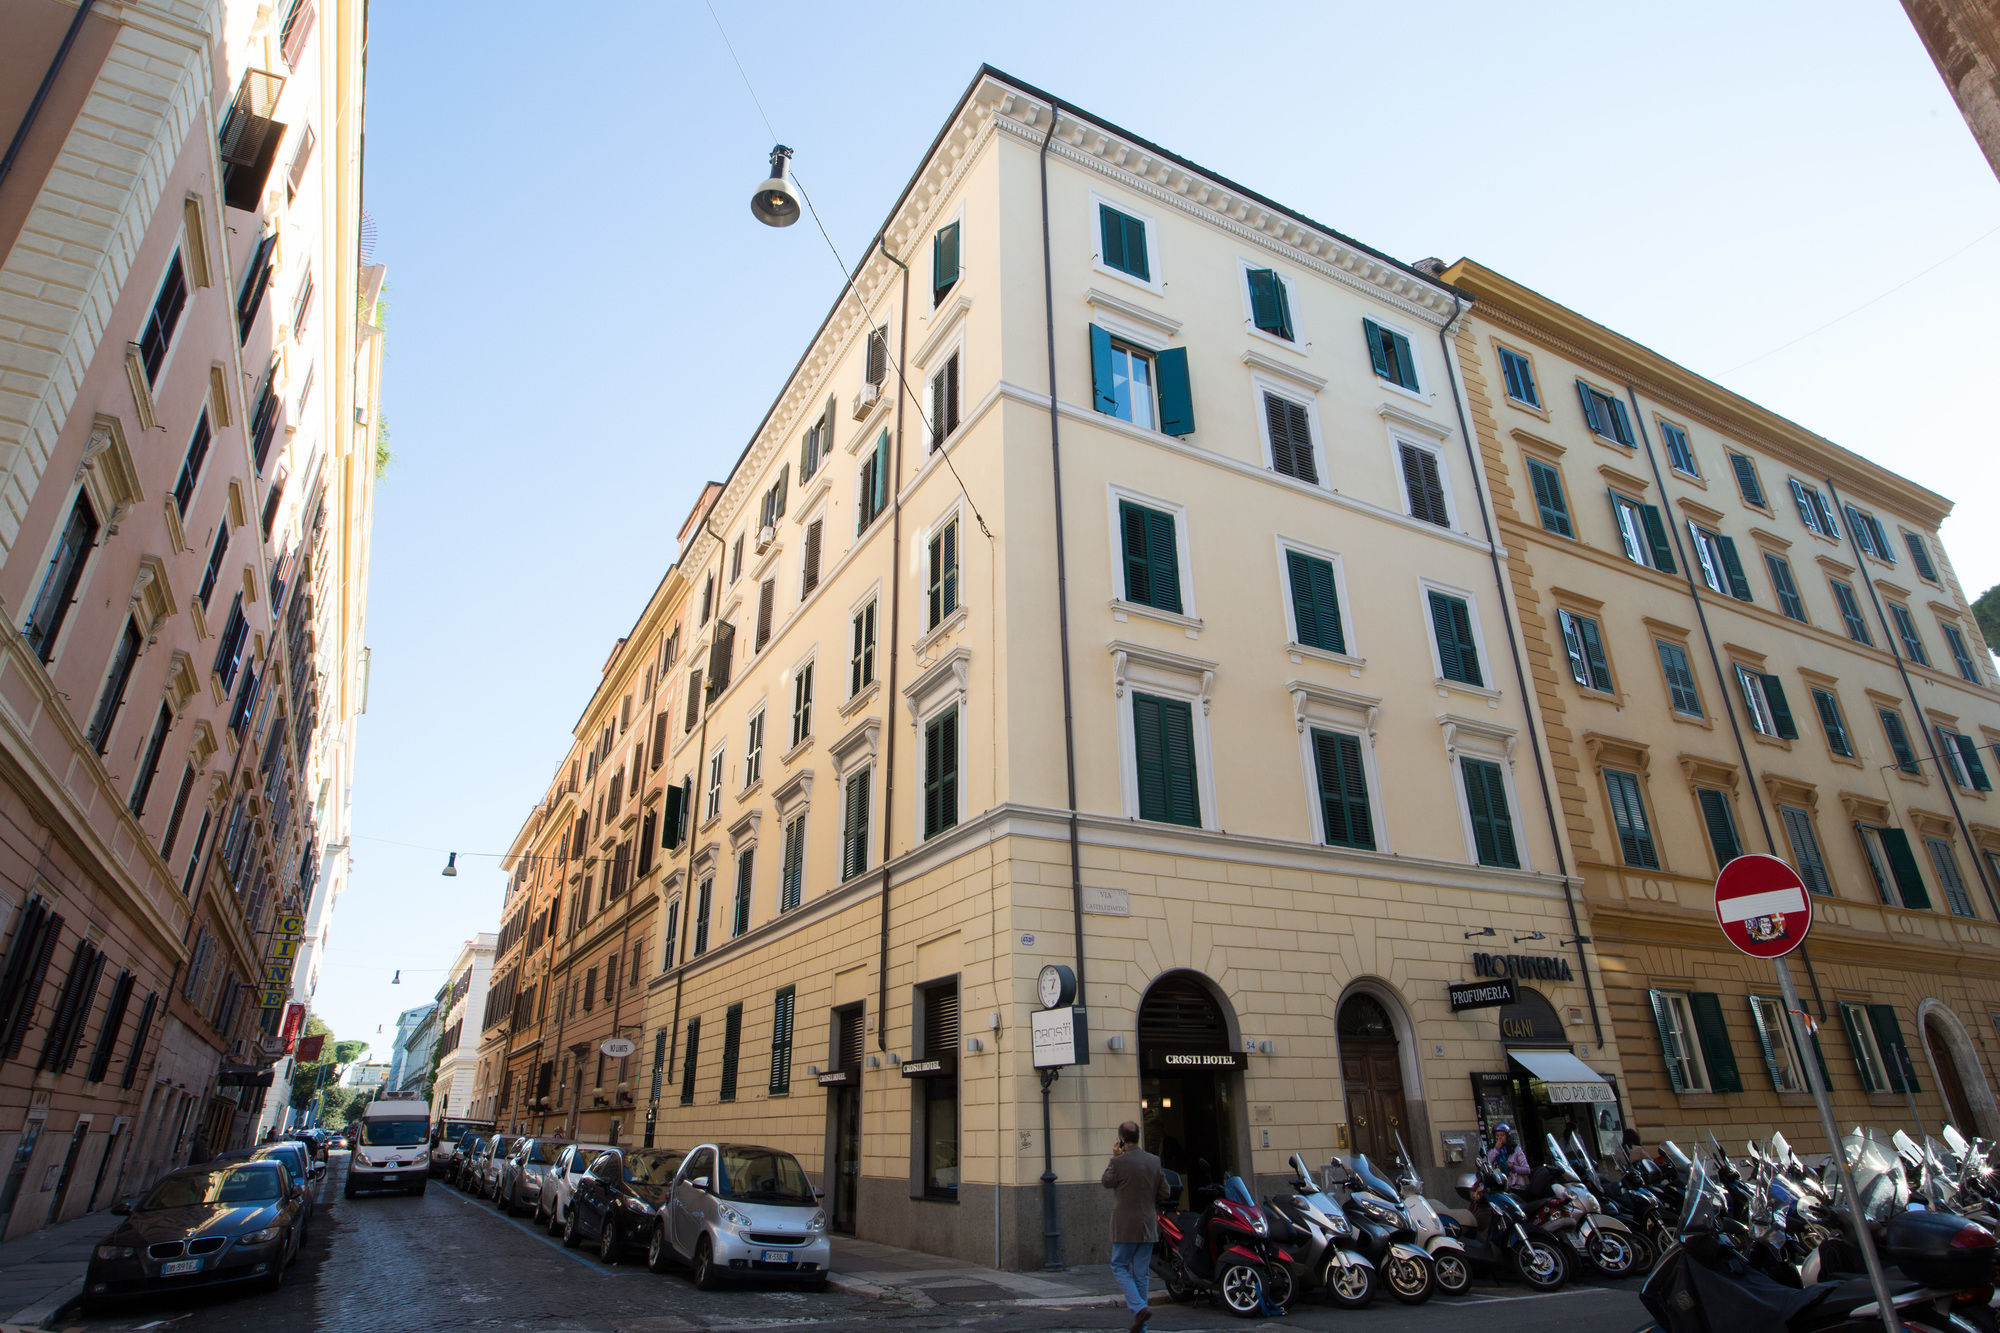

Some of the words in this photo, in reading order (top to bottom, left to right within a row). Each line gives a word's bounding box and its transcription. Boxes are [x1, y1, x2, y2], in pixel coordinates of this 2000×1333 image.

[1099, 891, 1112, 899] VIA
[1473, 952, 1574, 981] PROFUMERIA
[1452, 985, 1510, 1005] PROFUMERIA
[1502, 1018, 1534, 1038] CIANI
[1246, 1041, 1255, 1050] 54
[903, 1063, 921, 1073] CROSTI
[922, 1061, 941, 1071] HOTEL
[1165, 1055, 1201, 1064] CROSTI
[1203, 1055, 1236, 1065] HOTEL
[1549, 1086, 1571, 1101] TUTTO
[1573, 1086, 1586, 1101] PER
[1586, 1085, 1611, 1100] CAPELLI
